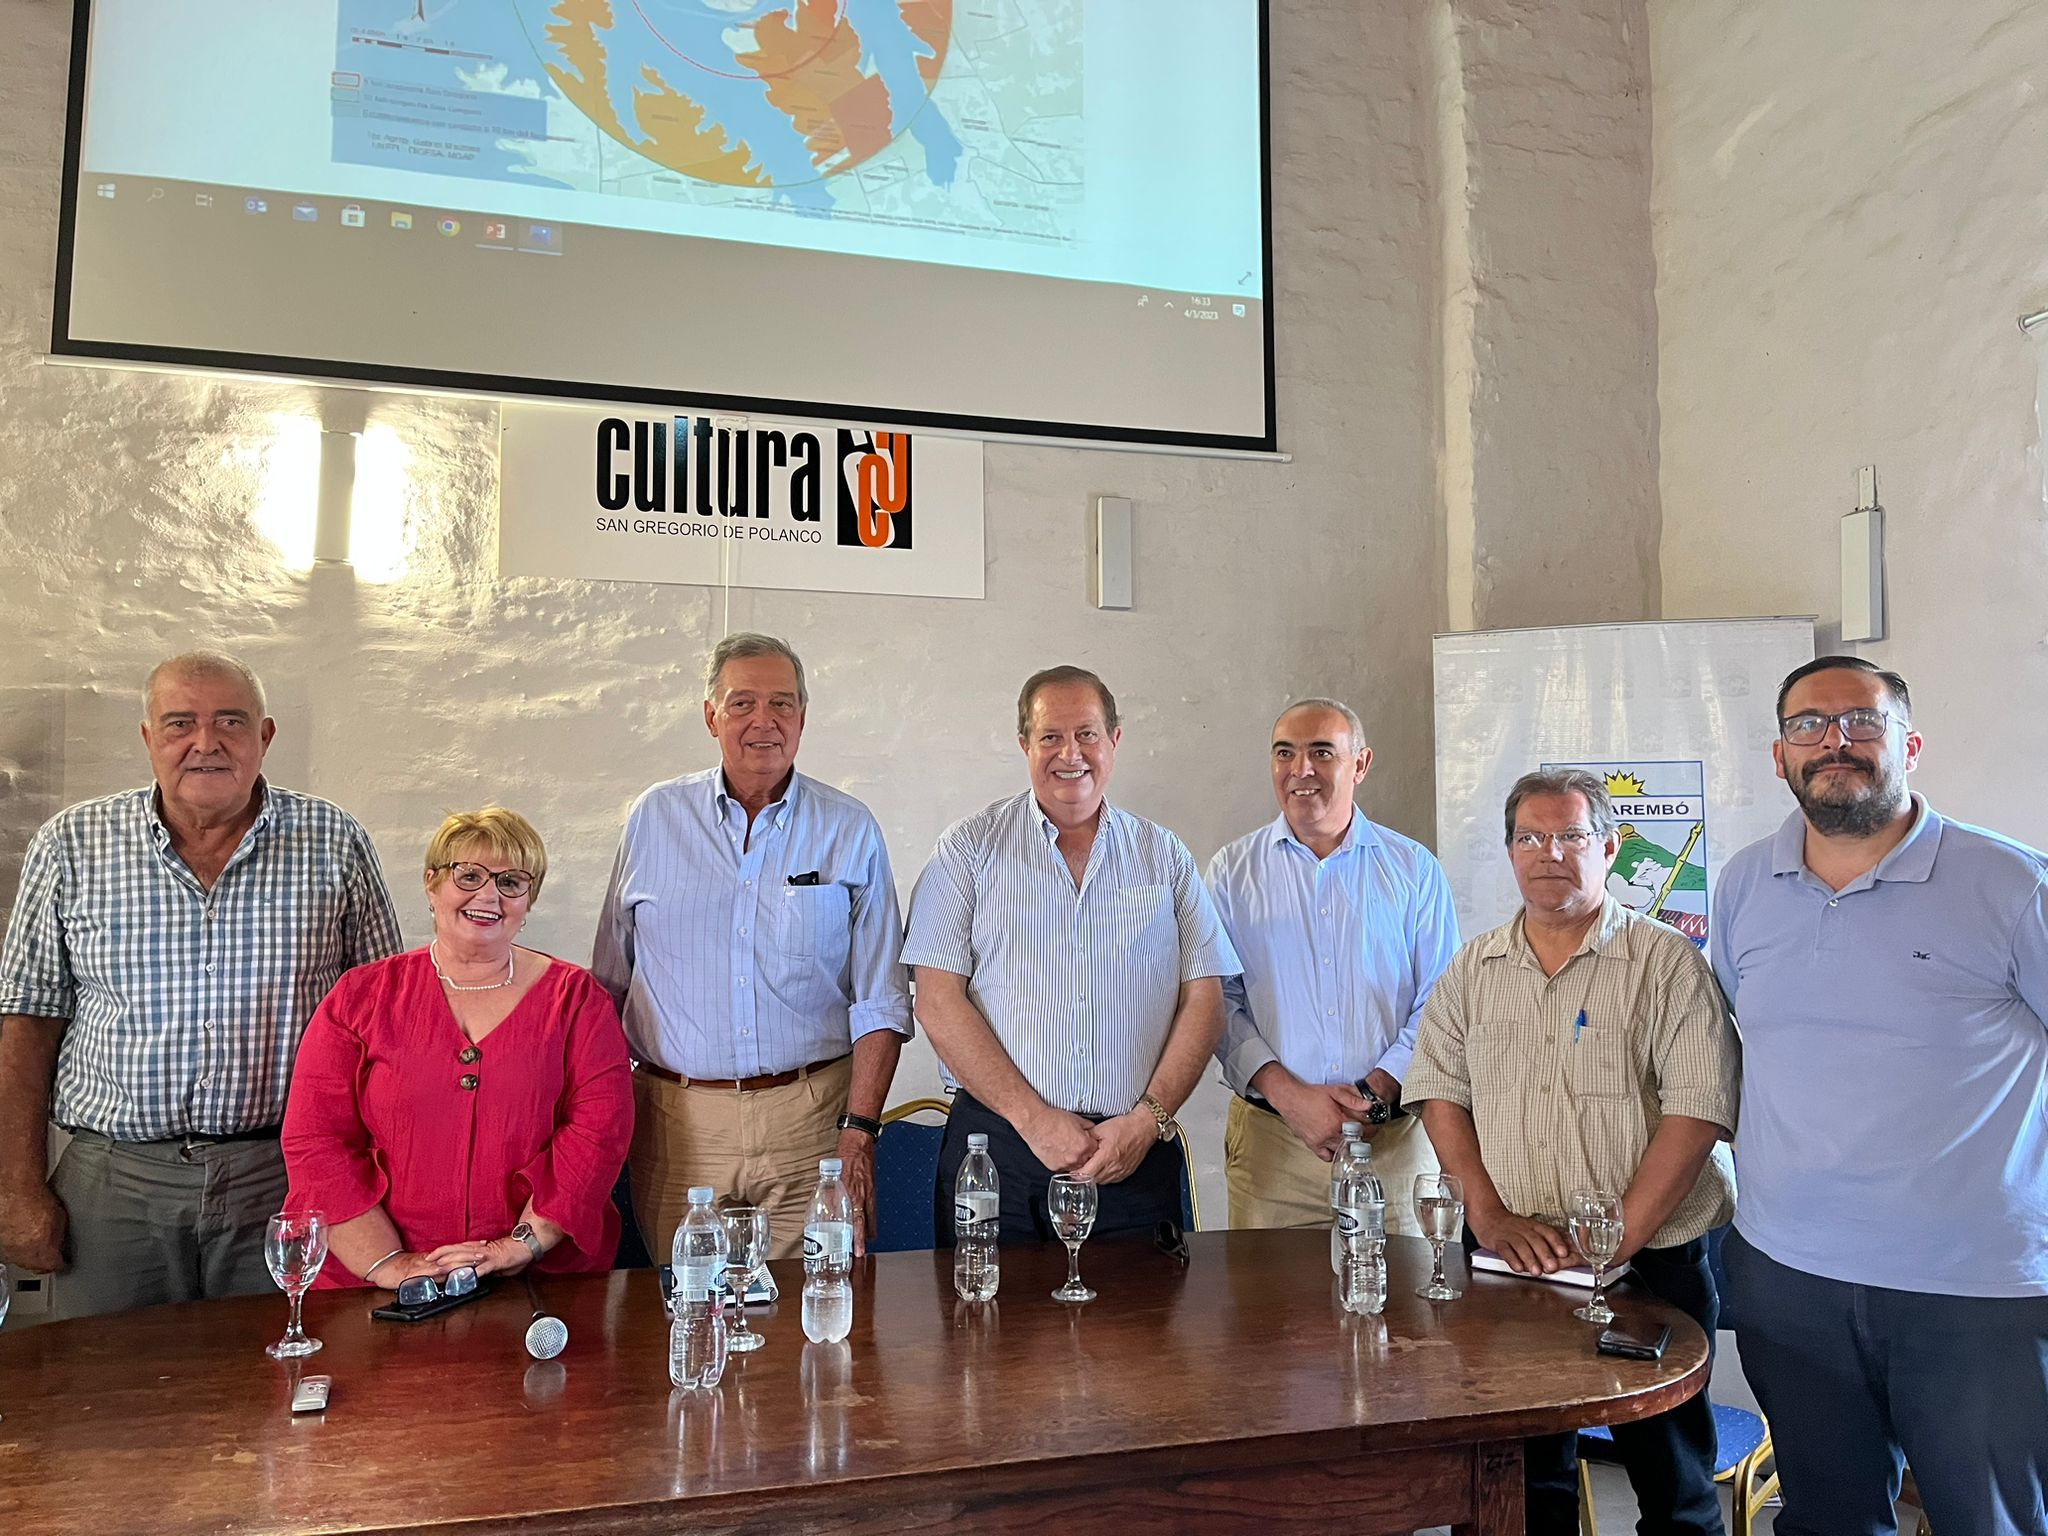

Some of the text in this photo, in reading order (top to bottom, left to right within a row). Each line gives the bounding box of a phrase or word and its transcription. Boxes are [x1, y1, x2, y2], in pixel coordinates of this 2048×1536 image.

[596, 415, 821, 522] cultura
[596, 517, 822, 545] SAN GREGORIO DE POLANCO
[1612, 801, 1690, 816] AREMBÓ
